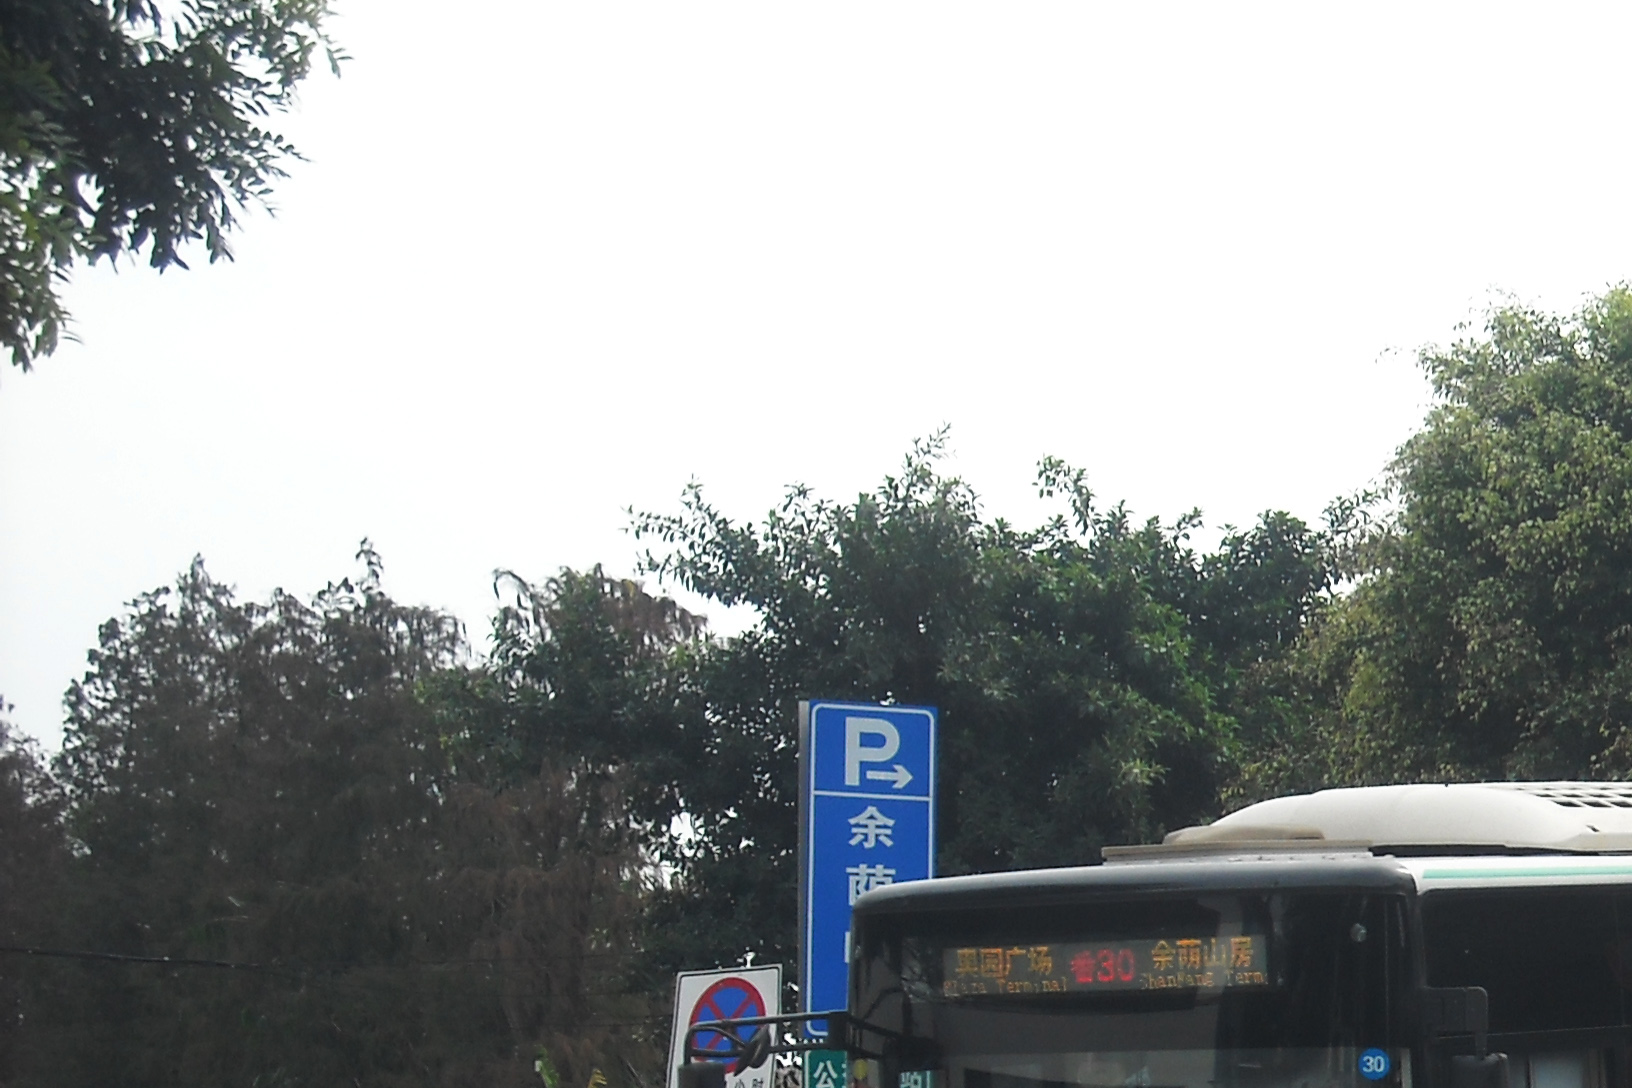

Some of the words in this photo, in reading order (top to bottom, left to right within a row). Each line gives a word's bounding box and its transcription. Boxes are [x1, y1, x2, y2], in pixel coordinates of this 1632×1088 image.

[845, 717, 900, 786] P
[955, 946, 1053, 978] 奥园广场
[1152, 936, 1254, 969] 余荫山房
[1362, 1055, 1386, 1073] 30
